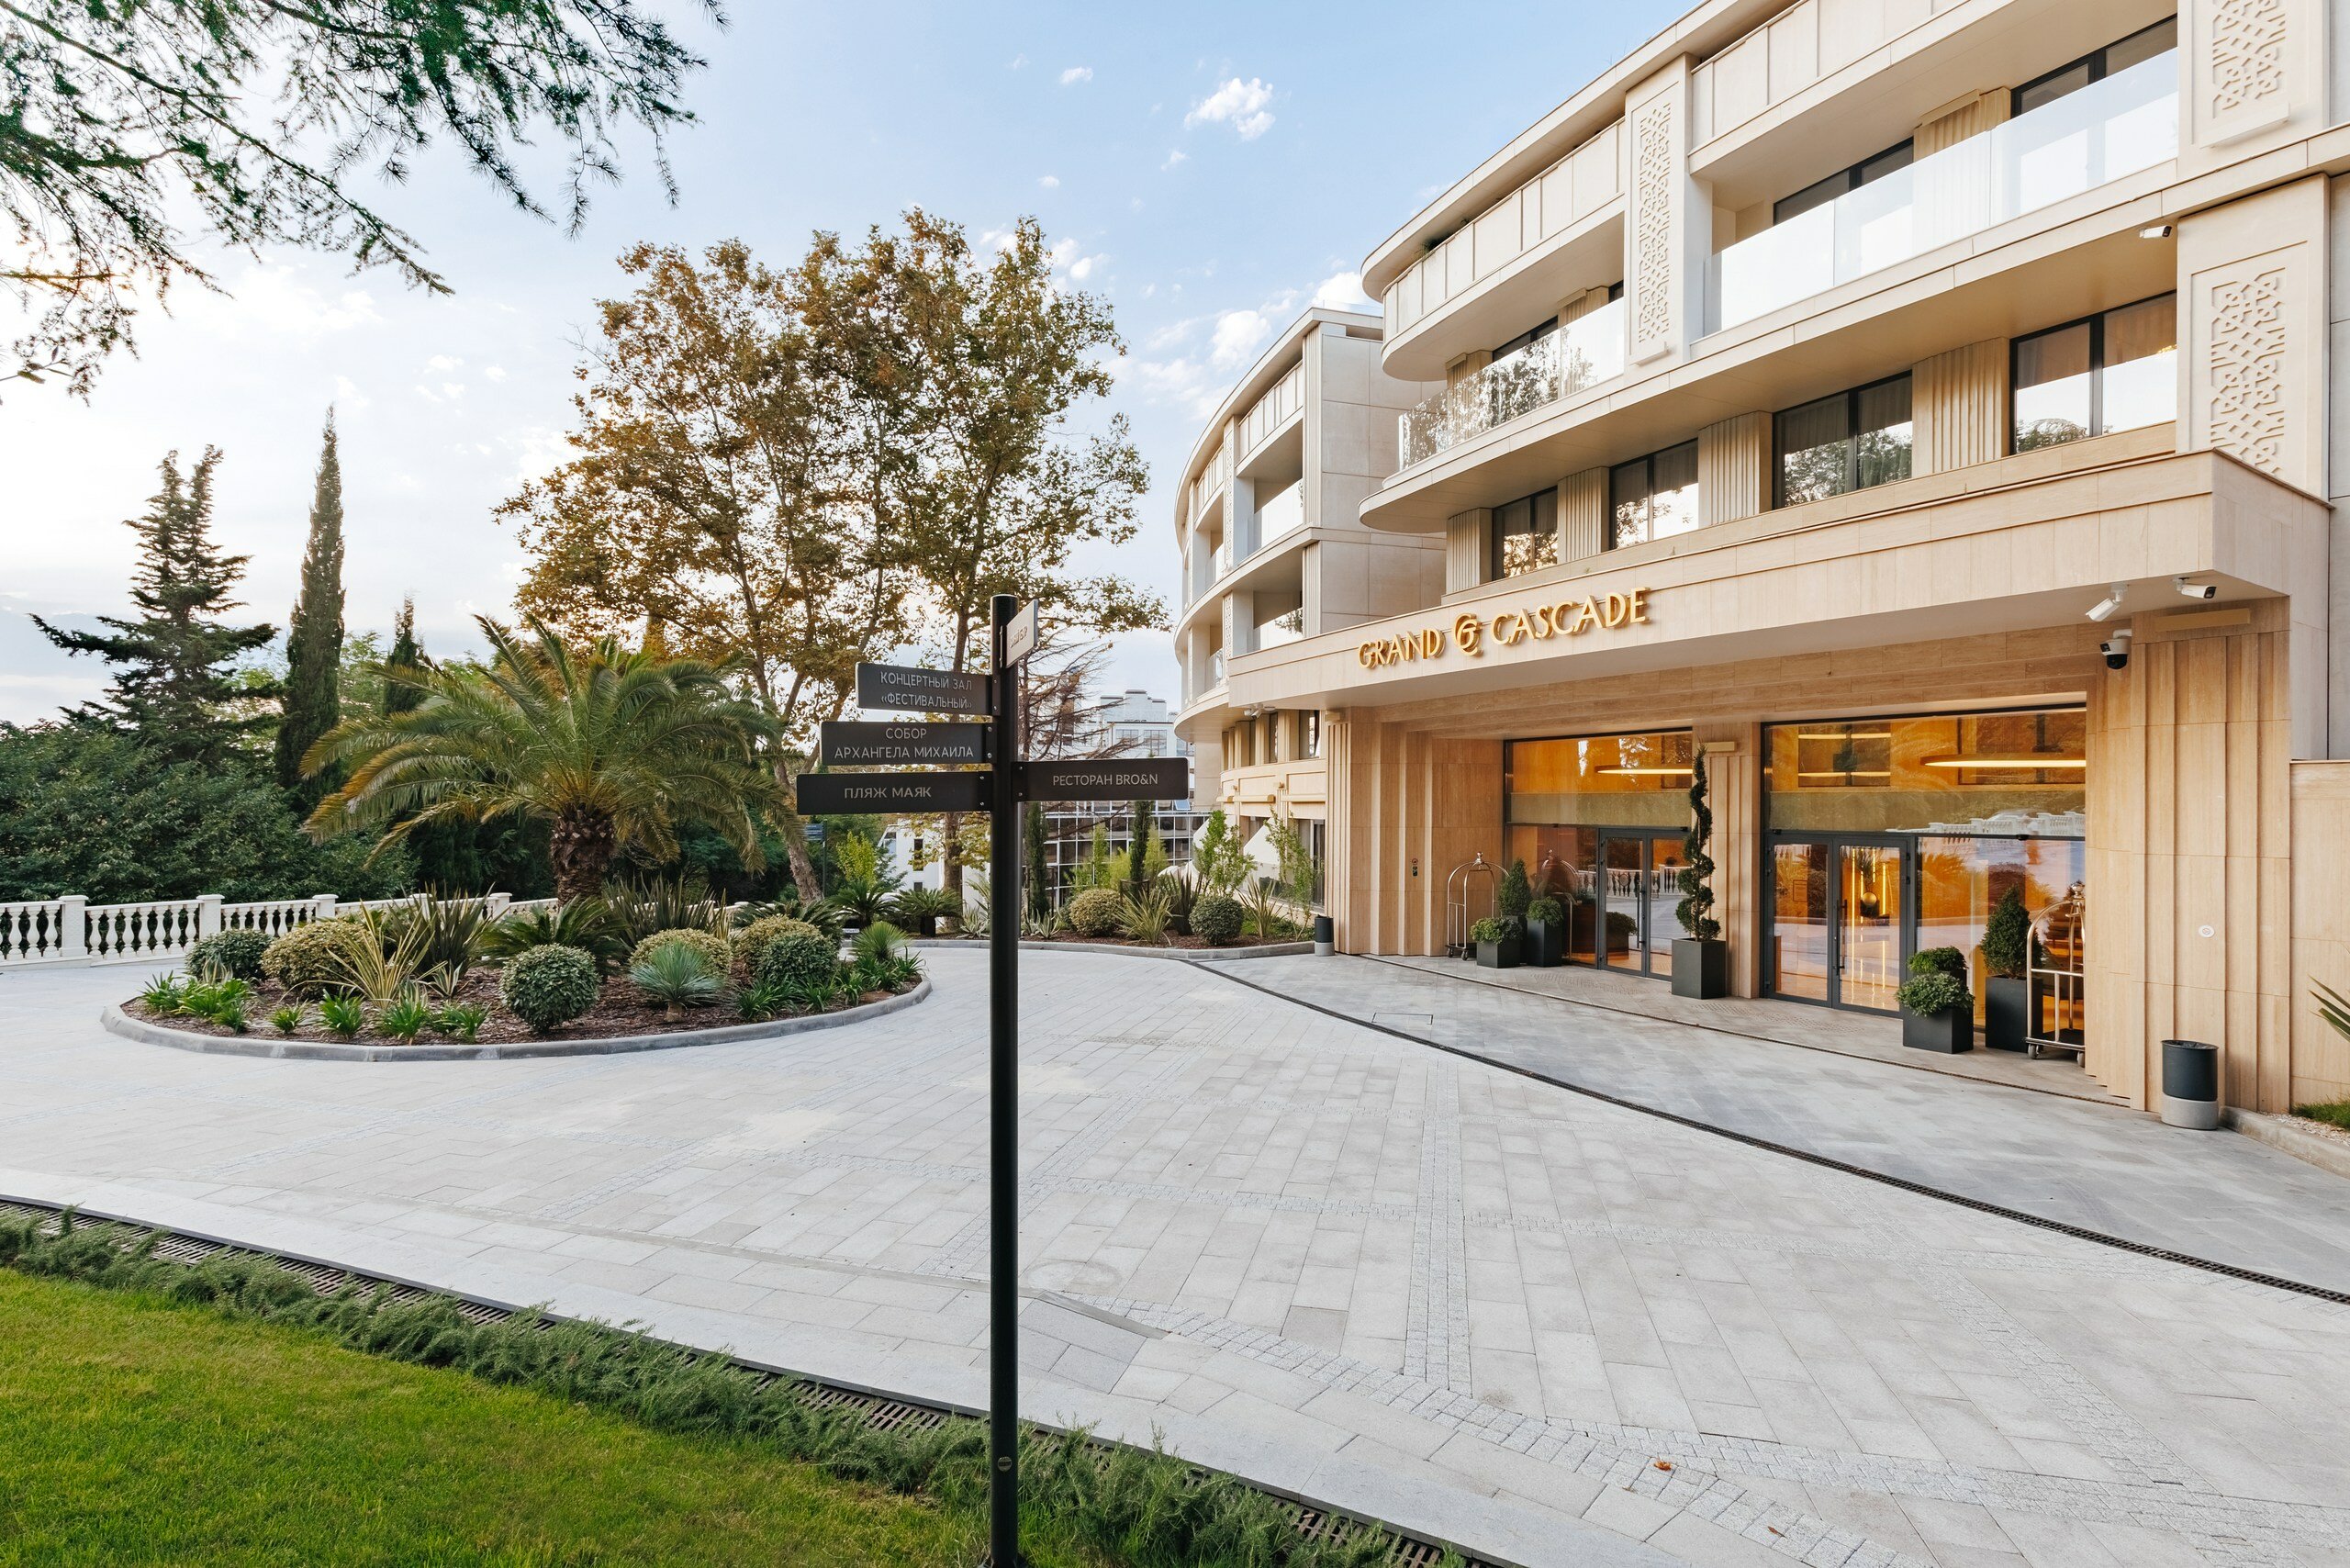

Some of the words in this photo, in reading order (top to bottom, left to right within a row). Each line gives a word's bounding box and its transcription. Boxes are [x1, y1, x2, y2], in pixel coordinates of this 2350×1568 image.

[1359, 628, 1446, 668] GRAND
[1490, 587, 1651, 644] CASCADE
[880, 671, 949, 689] КОНЦЕРТНЫЙ
[953, 678, 972, 691] ЗАЛ
[885, 728, 927, 739] СОБОР
[834, 746, 911, 759] АРХАНГЕЛА
[914, 746, 974, 757] МИХАИЛА
[1053, 774, 1113, 786] РЕСТОРАН
[1116, 774, 1158, 785] BRO&N
[845, 788, 888, 799] ПЛЯЖ
[892, 787, 932, 798] МАЯК
